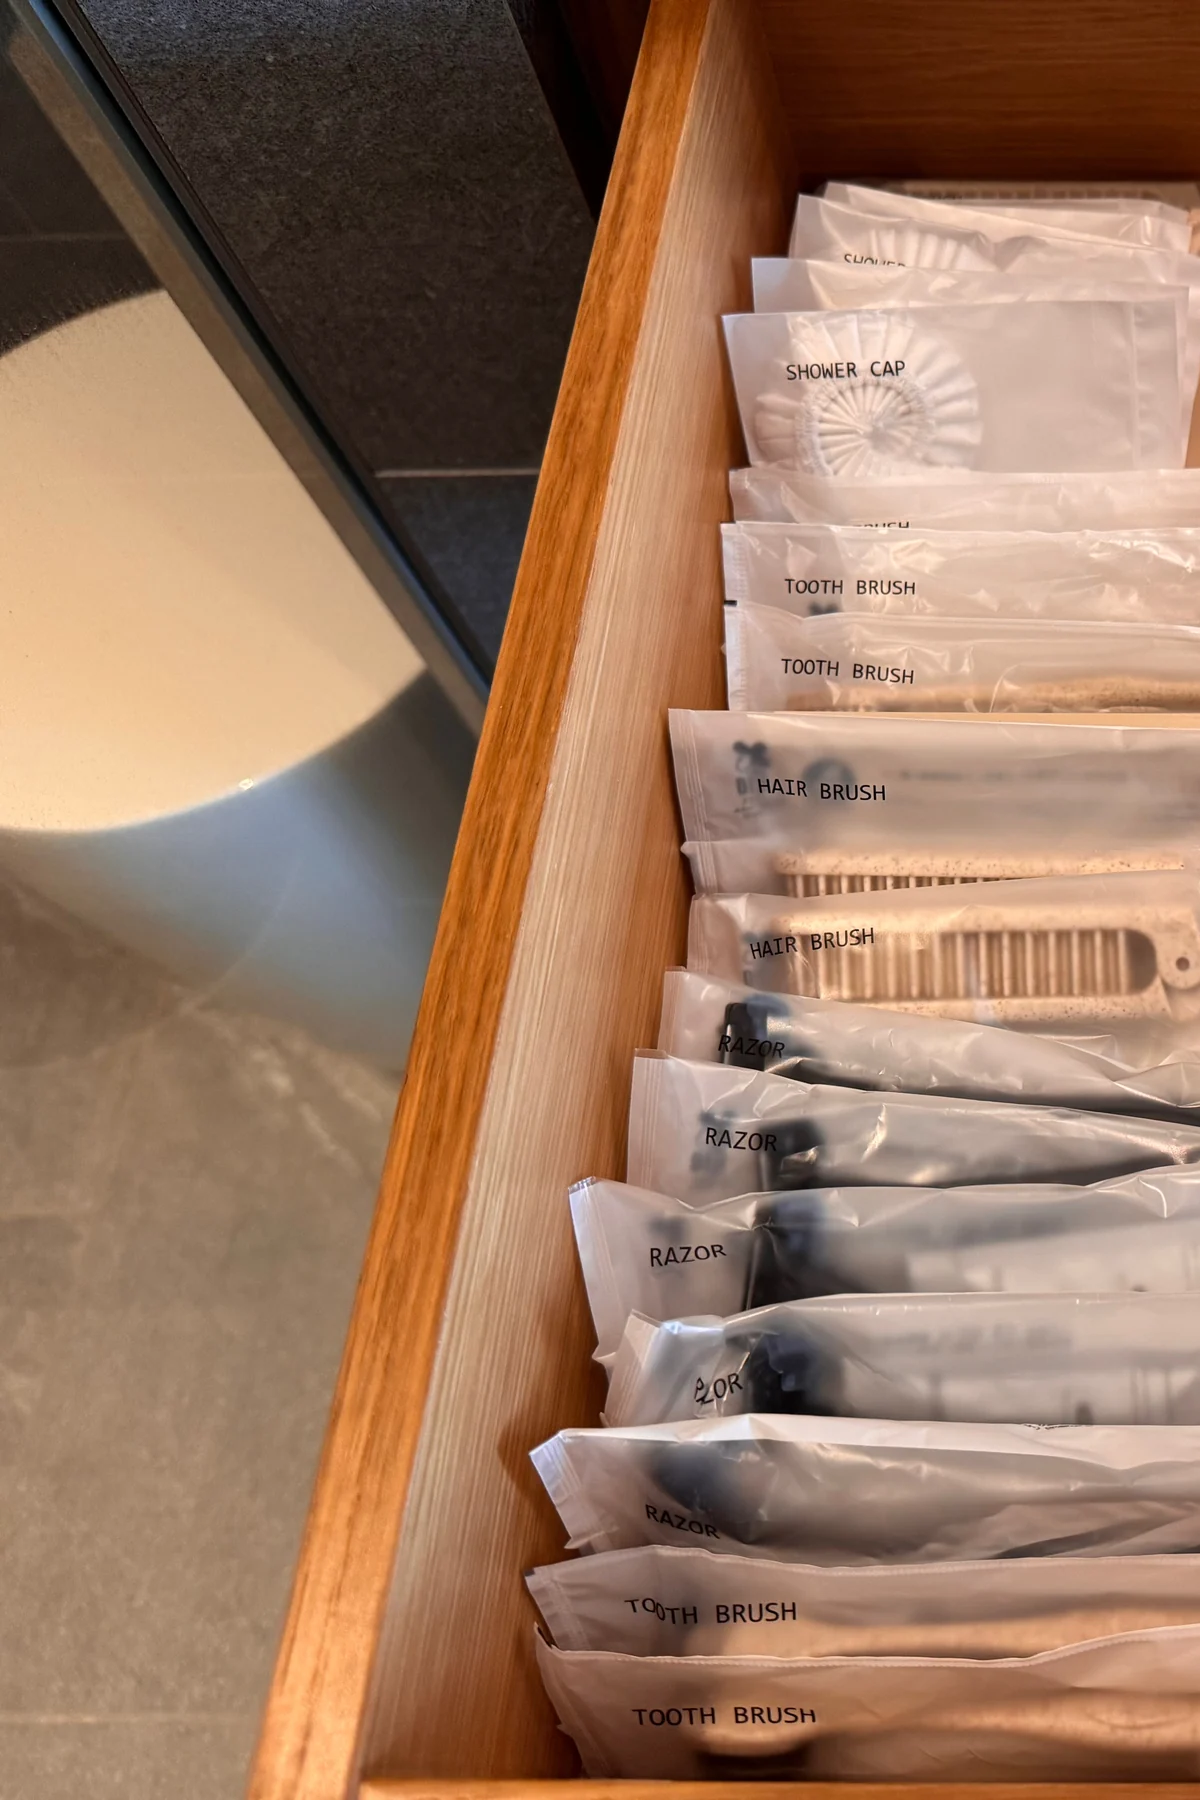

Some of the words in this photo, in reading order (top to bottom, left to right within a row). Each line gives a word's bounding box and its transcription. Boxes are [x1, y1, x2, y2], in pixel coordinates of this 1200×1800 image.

[786, 362, 857, 381] SHOWER
[870, 360, 906, 377] CAP
[785, 578, 844, 595] TOOTH
[856, 580, 916, 596] BRUSH
[781, 658, 840, 677] TOOTH
[852, 663, 915, 685] BRUSH
[757, 778, 808, 798] HAIR
[820, 783, 886, 801] BRUSH
[750, 936, 797, 960] HAIR
[810, 926, 875, 952] BRUSH
[718, 1034, 785, 1059] RAZOR
[705, 1127, 777, 1151] RAZOR
[650, 1244, 727, 1267] RAZOR
[645, 1503, 720, 1540] RAZOR
[624, 1598, 698, 1625] TOOTH
[715, 1602, 797, 1624] BRUSH
[632, 1708, 716, 1727] TOOTH
[733, 1706, 816, 1725] BRUSH
